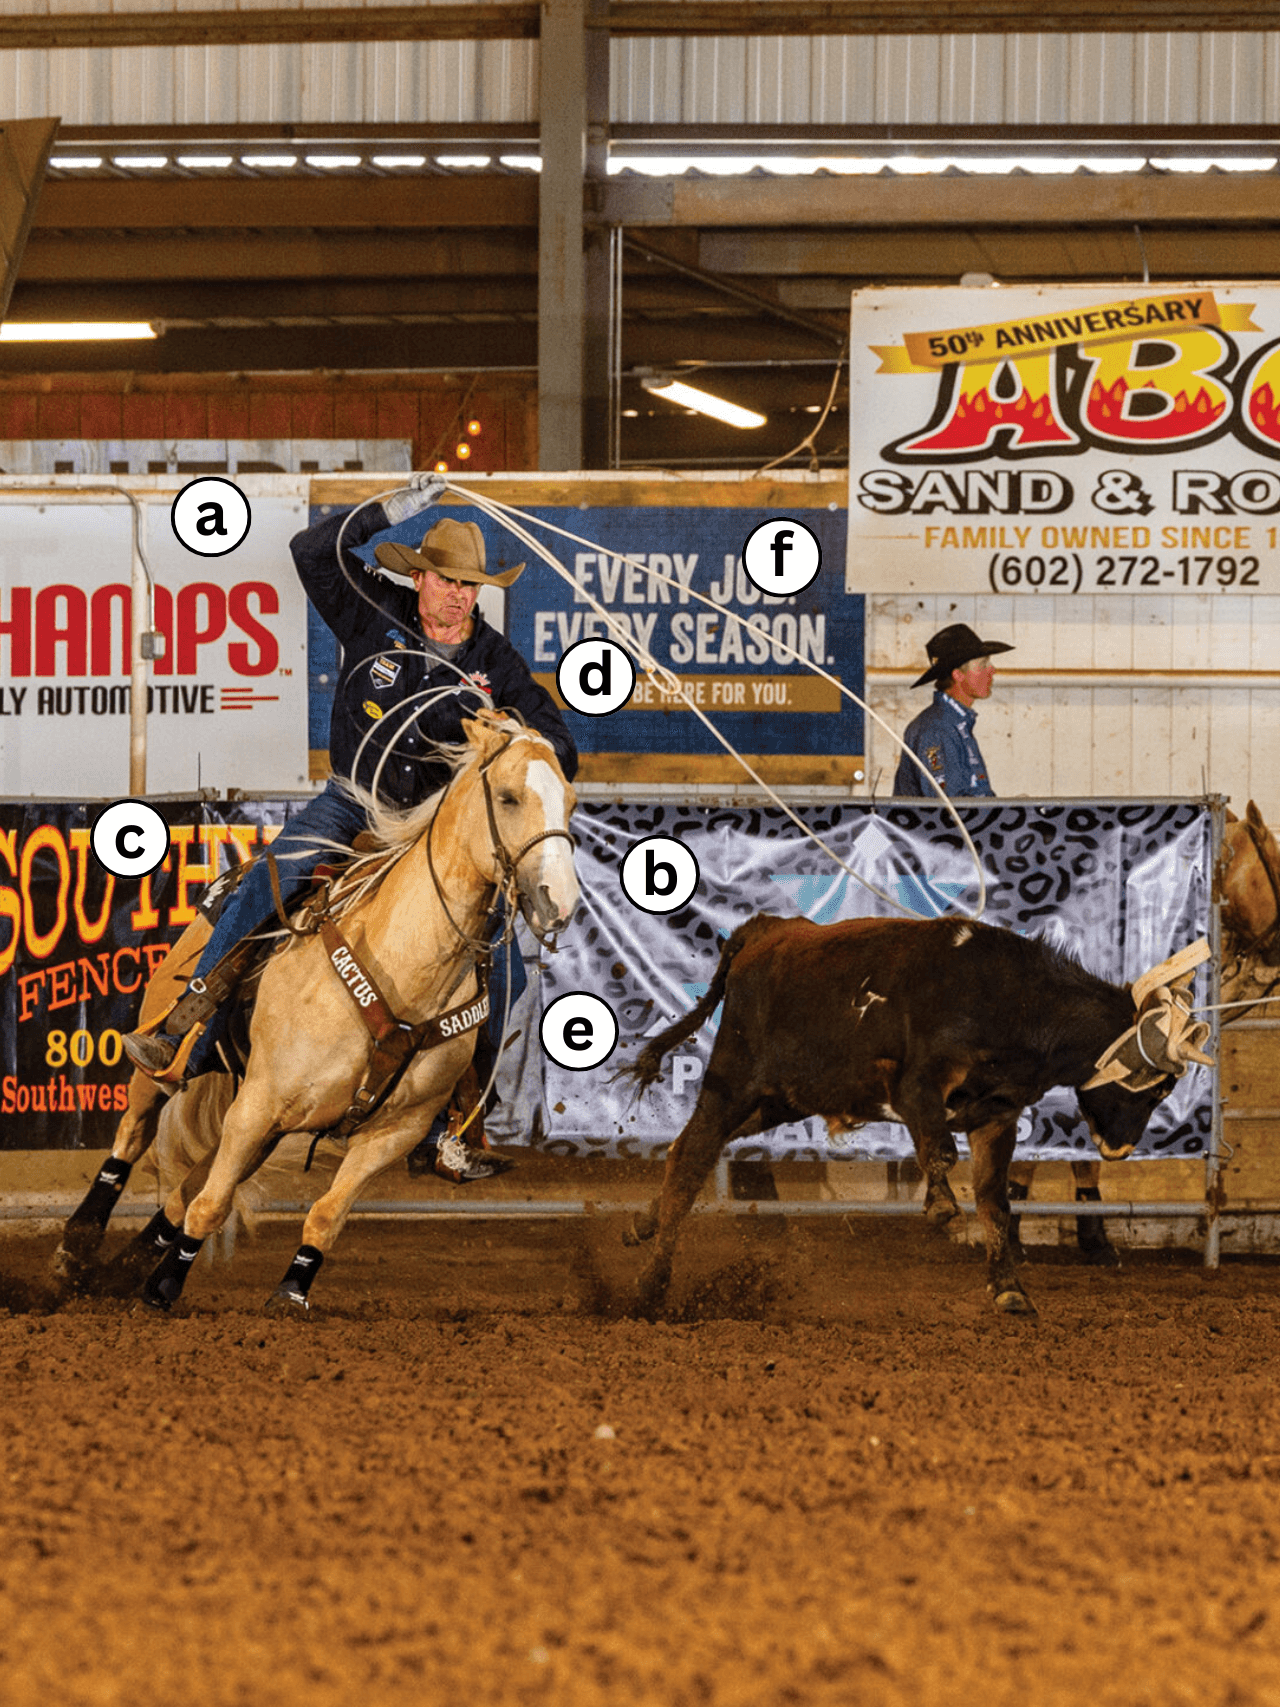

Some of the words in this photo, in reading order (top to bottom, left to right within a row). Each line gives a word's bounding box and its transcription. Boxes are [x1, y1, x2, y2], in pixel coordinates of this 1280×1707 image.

[996, 297, 1203, 350] ANNIVERSARY
[858, 469, 1074, 515] SAND
[1091, 469, 1155, 515] &
[924, 526, 1032, 549] FAMILY
[1041, 526, 1151, 549] OWNED
[1161, 526, 1251, 549] SINCE
[574, 553, 699, 605] EVERY
[988, 553, 1084, 593] (602)
[1096, 556, 1260, 587] 272-1792
[669, 613, 835, 665] SEASON.
[633, 681, 654, 704] BE
[712, 682, 745, 705] FOR
[752, 682, 792, 706] YOU.
[331, 945, 378, 1008] CACTUS
[45, 1028, 122, 1068] 800
[0, 1073, 131, 1115] Southwes
